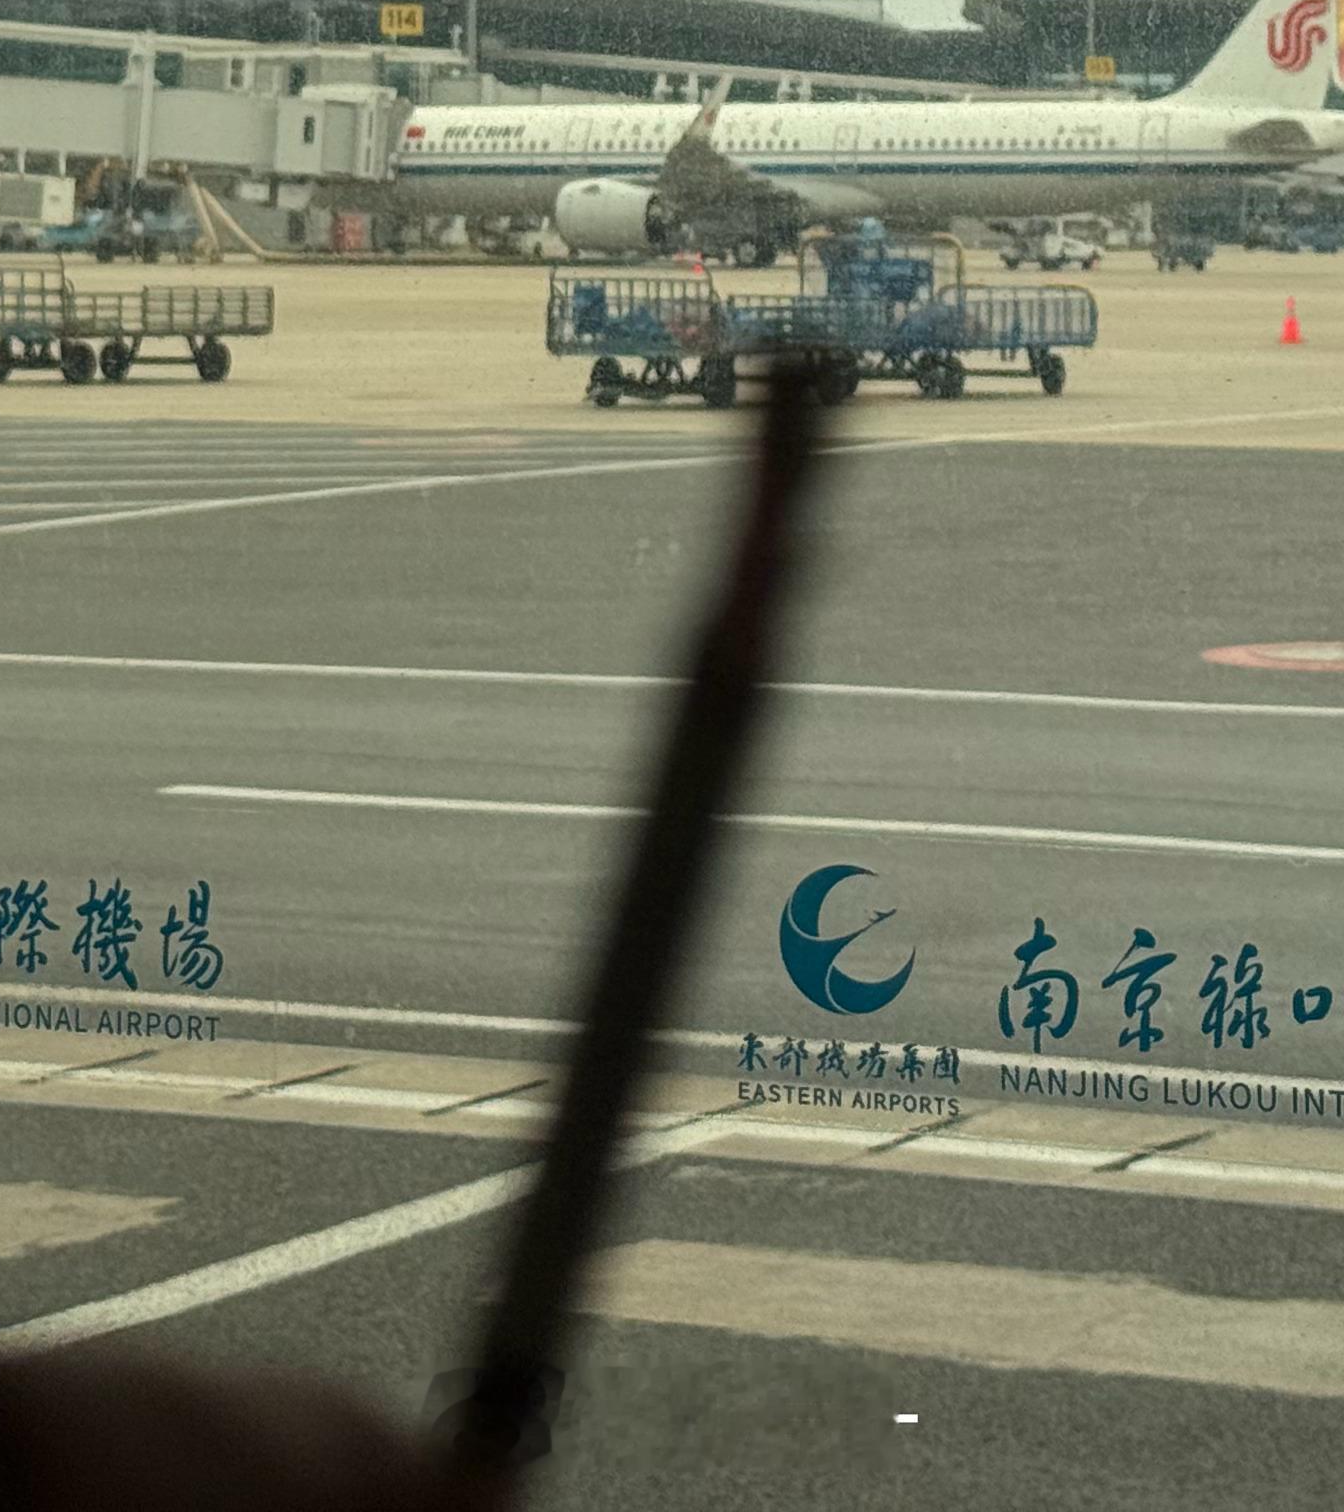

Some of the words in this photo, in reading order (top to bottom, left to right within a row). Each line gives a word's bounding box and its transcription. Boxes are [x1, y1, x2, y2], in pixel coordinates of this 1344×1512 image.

[96, 1008, 221, 1042] AIRPORT
[737, 1080, 843, 1108] EASTERN
[851, 1091, 961, 1117] AIRPORTS
[1000, 1063, 1150, 1103] NANJING
[1163, 1075, 1279, 1113] LUKOU
